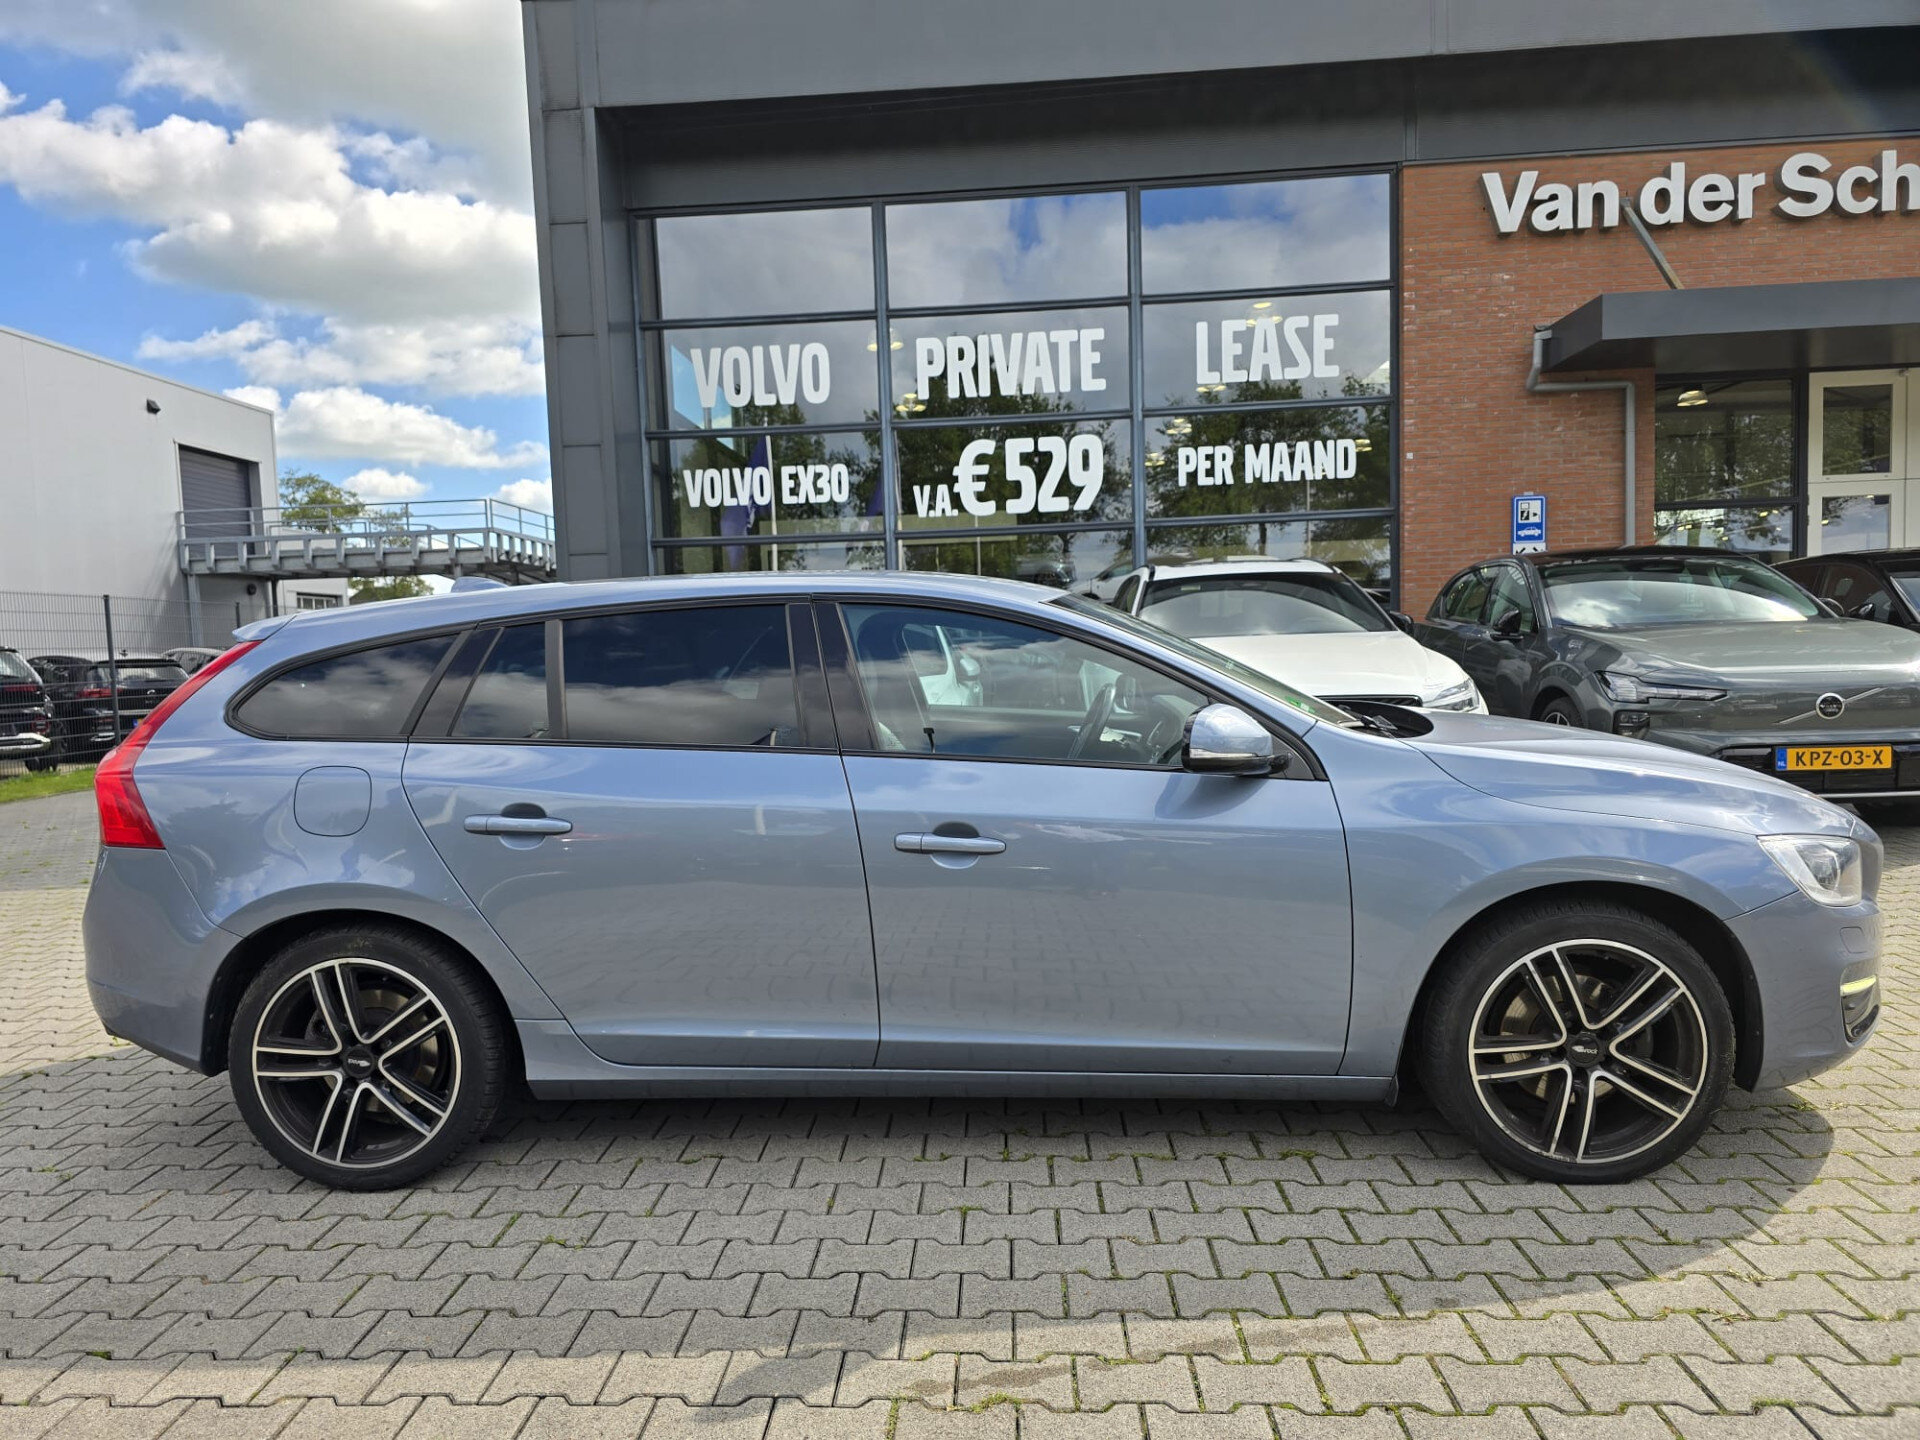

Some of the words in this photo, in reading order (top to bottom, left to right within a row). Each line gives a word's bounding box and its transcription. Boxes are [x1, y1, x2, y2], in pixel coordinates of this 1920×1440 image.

[1481, 170, 1620, 233] Van
[1638, 161, 1766, 226] der
[1776, 149, 1920, 218] Sch
[690, 342, 831, 408] VOLVO
[915, 328, 1107, 400] PRIVATE
[1195, 313, 1340, 385] LEASE
[683, 466, 772, 508] VOLVO
[780, 463, 850, 505] EX30
[1177, 445, 1235, 487] PER
[1244, 438, 1357, 484] MAAND
[913, 484, 959, 518] V.A.
[1795, 749, 1884, 767] KPZ-03-X
